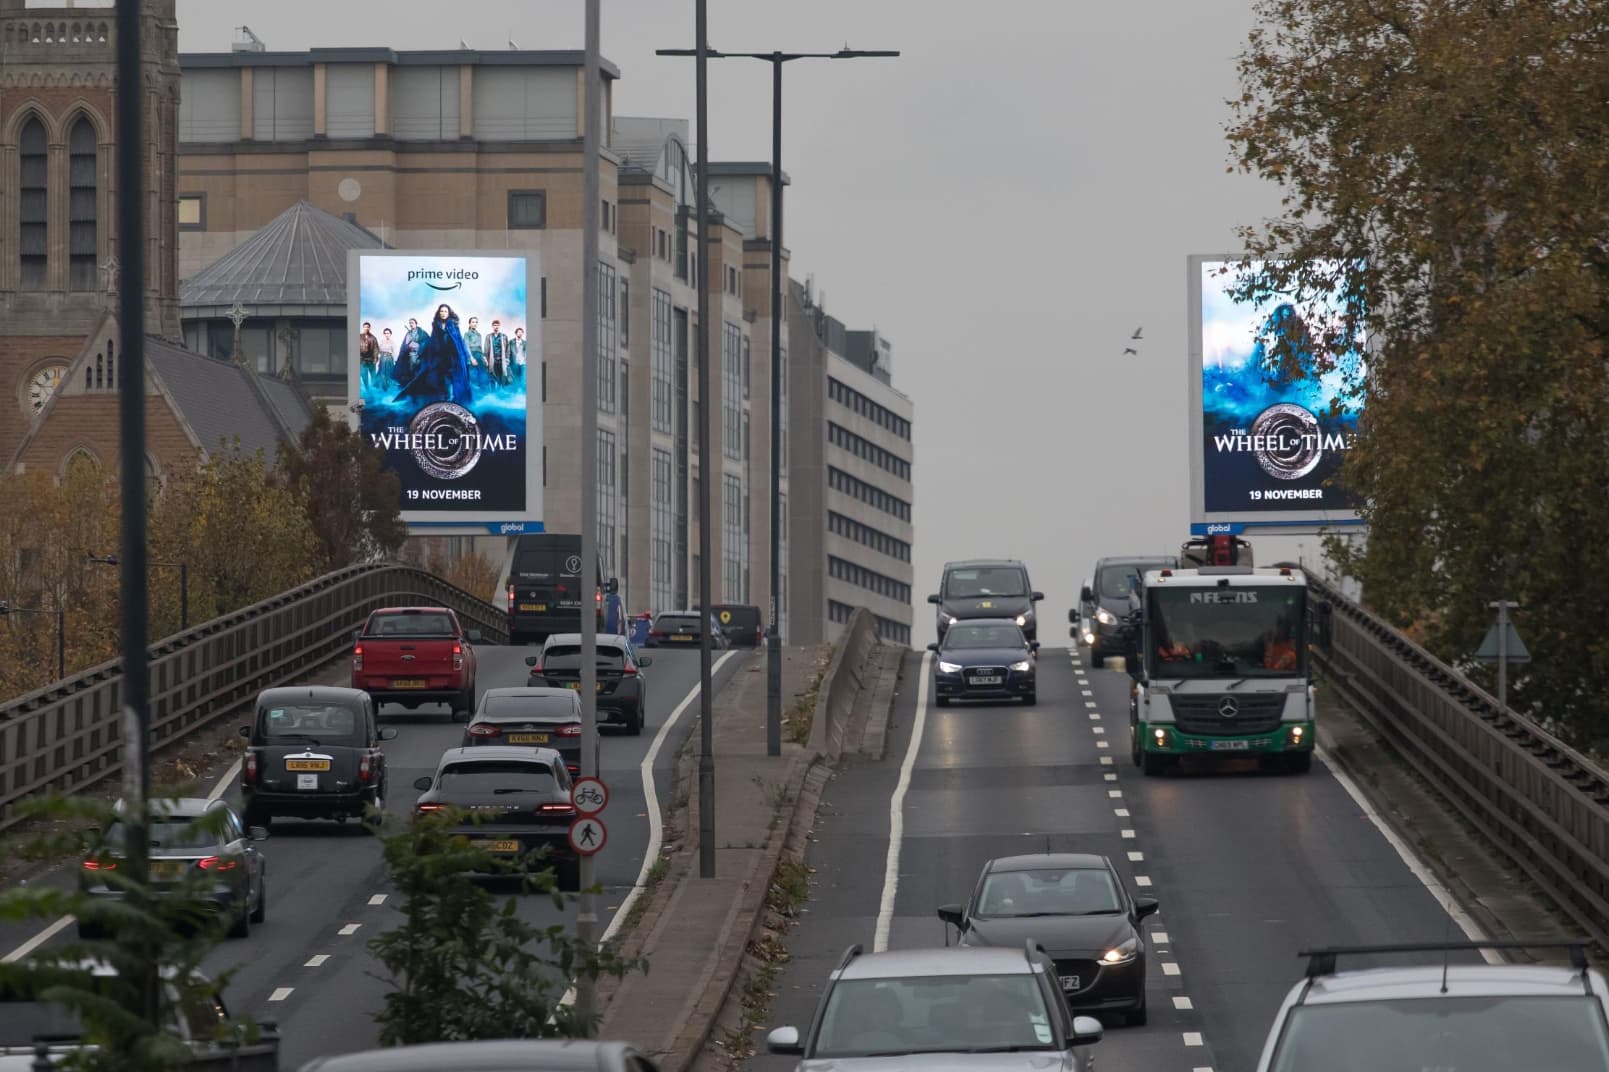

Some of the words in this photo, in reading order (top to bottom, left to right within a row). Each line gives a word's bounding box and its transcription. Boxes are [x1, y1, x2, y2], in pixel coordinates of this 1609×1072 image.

[407, 268, 443, 281] prime
[447, 269, 479, 280] video
[371, 432, 449, 450] WHEEL
[460, 433, 517, 453] TIME
[1214, 434, 1290, 453] WHEEL
[1289, 438, 1300, 446] OF
[407, 490, 419, 499] 19
[422, 490, 481, 500] NOVEMBER
[1249, 490, 1262, 500] 19
[1264, 489, 1323, 499] NOVEMBER
[500, 523, 524, 534] global
[1207, 524, 1230, 535] global
